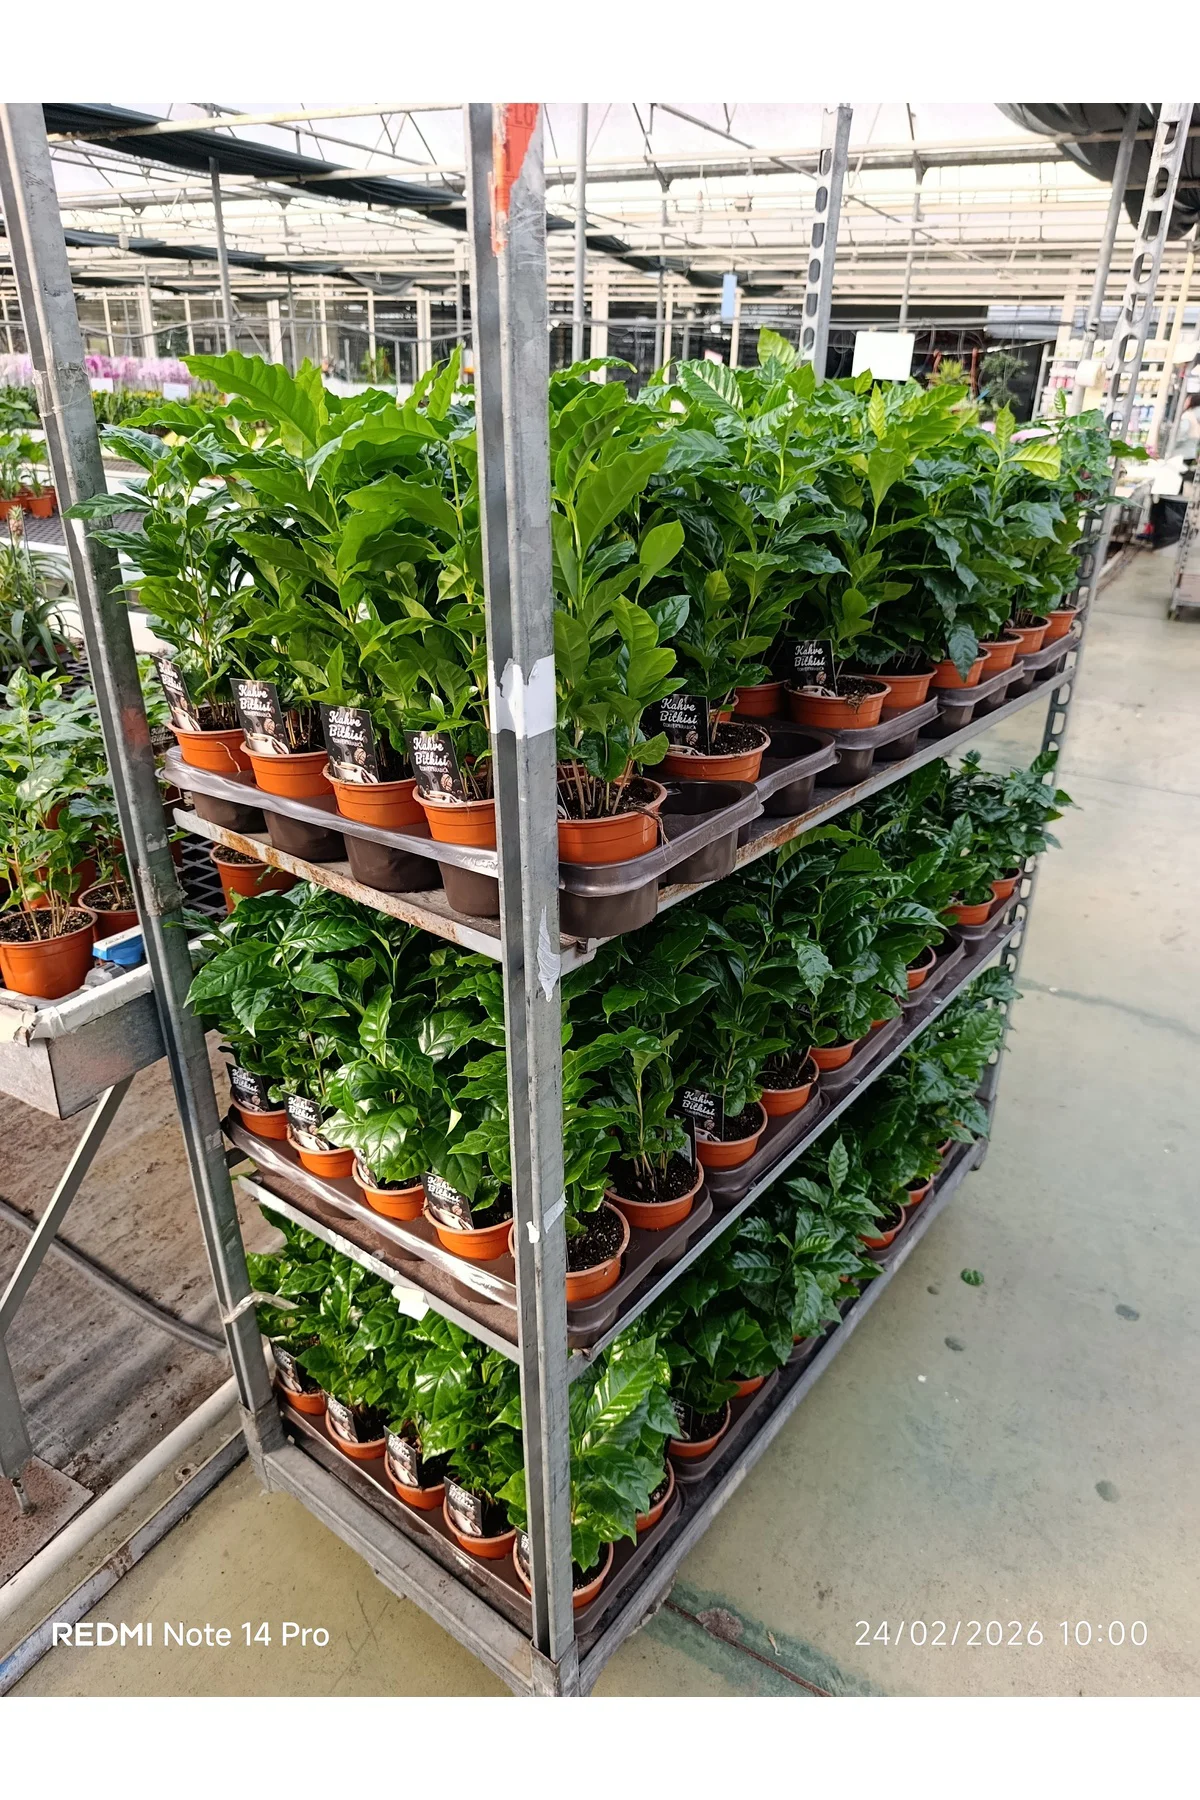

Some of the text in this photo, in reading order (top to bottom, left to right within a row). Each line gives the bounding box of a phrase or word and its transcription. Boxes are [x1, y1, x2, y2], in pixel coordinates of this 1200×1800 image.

[794, 643, 823, 656] Kahve
[794, 655, 826, 668] Bitkisi
[238, 684, 268, 699] Kahve
[239, 698, 272, 712] Bitkisi
[660, 697, 696, 712] Kahve
[328, 710, 362, 727] Kahve
[659, 710, 698, 725] Bitkisi
[328, 724, 365, 741] Bitkisi
[413, 737, 444, 751] Kahve
[414, 751, 449, 766] Bitkisi
[683, 1090, 715, 1107] Kahve
[681, 1100, 716, 1116] Bitkisi
